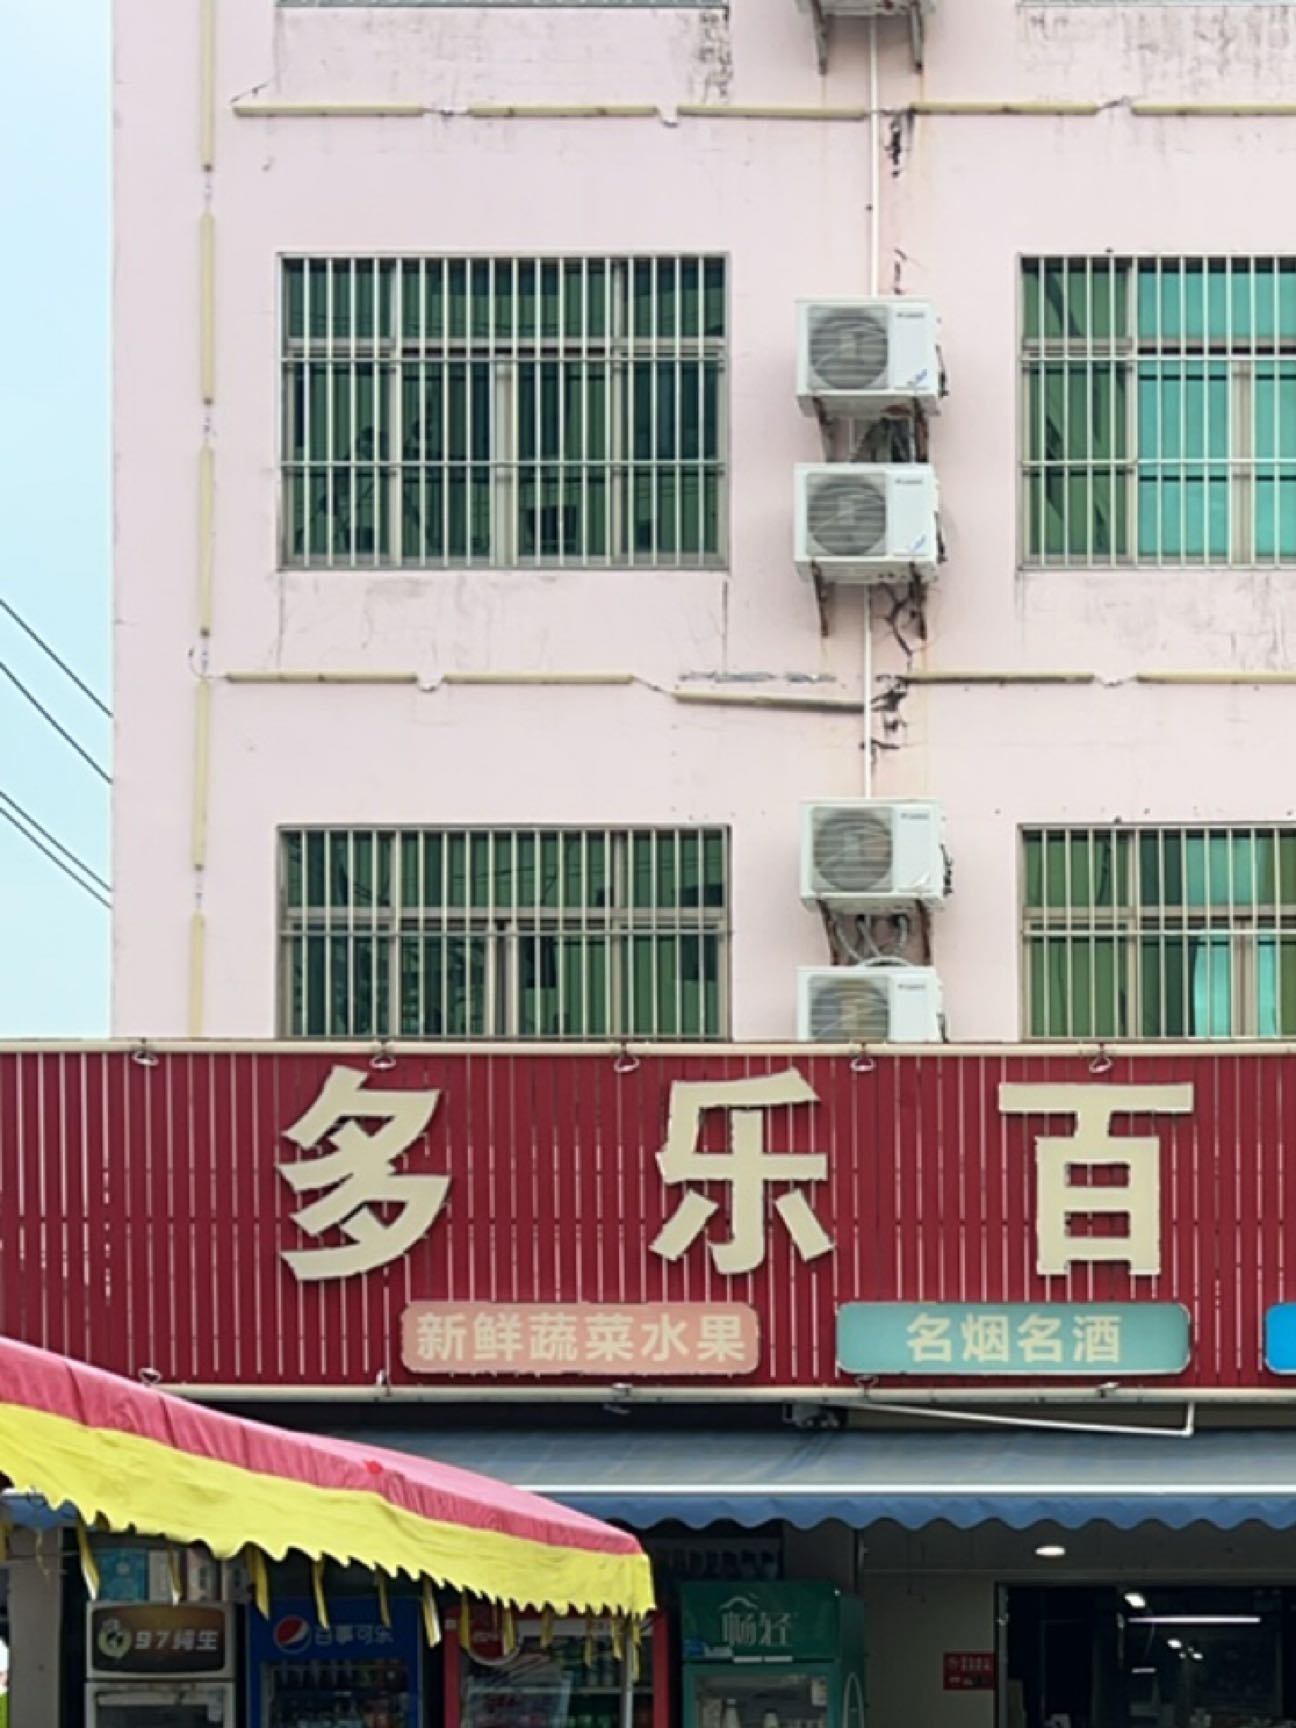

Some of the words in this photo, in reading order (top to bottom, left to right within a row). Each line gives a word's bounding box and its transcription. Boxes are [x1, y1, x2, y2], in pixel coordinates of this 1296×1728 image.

[416, 1312, 746, 1362] 新鲜蔬菜水果
[904, 1312, 1122, 1362] 名烟名酒
